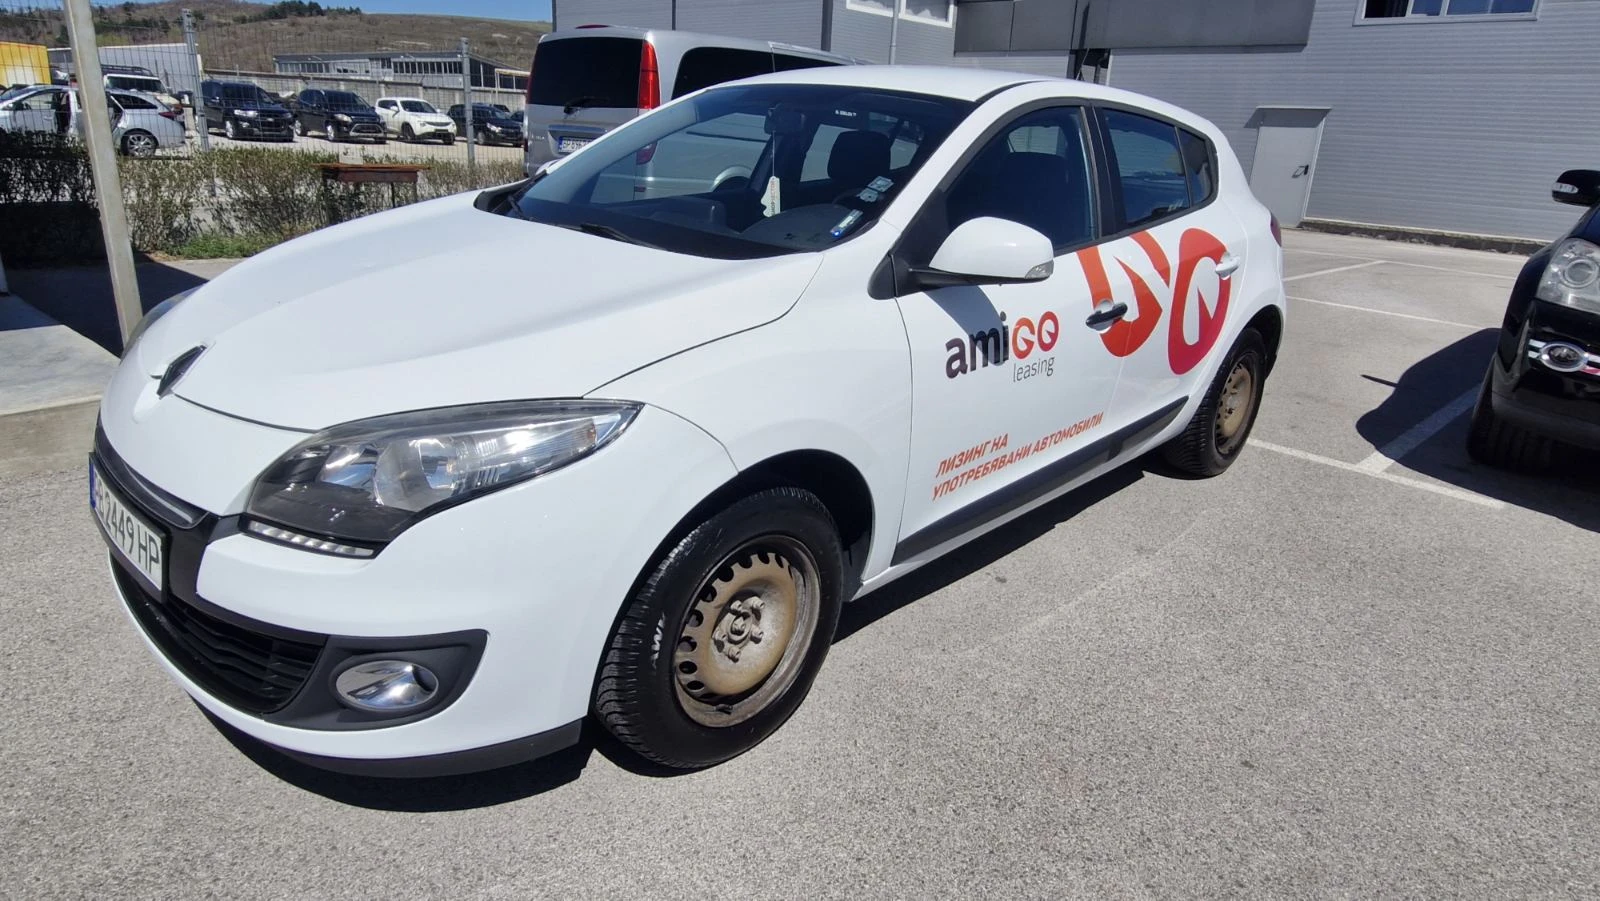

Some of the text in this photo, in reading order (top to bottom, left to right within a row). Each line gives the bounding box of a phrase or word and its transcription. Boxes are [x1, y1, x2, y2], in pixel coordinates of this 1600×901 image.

[1013, 356, 1055, 382] leasing
[932, 412, 1105, 502] УПОТРЕБЯВАНИ АВТОМОБИЛИ
[935, 433, 1009, 477] ЛИЗИНГ НА
[138, 524, 160, 575] HP
